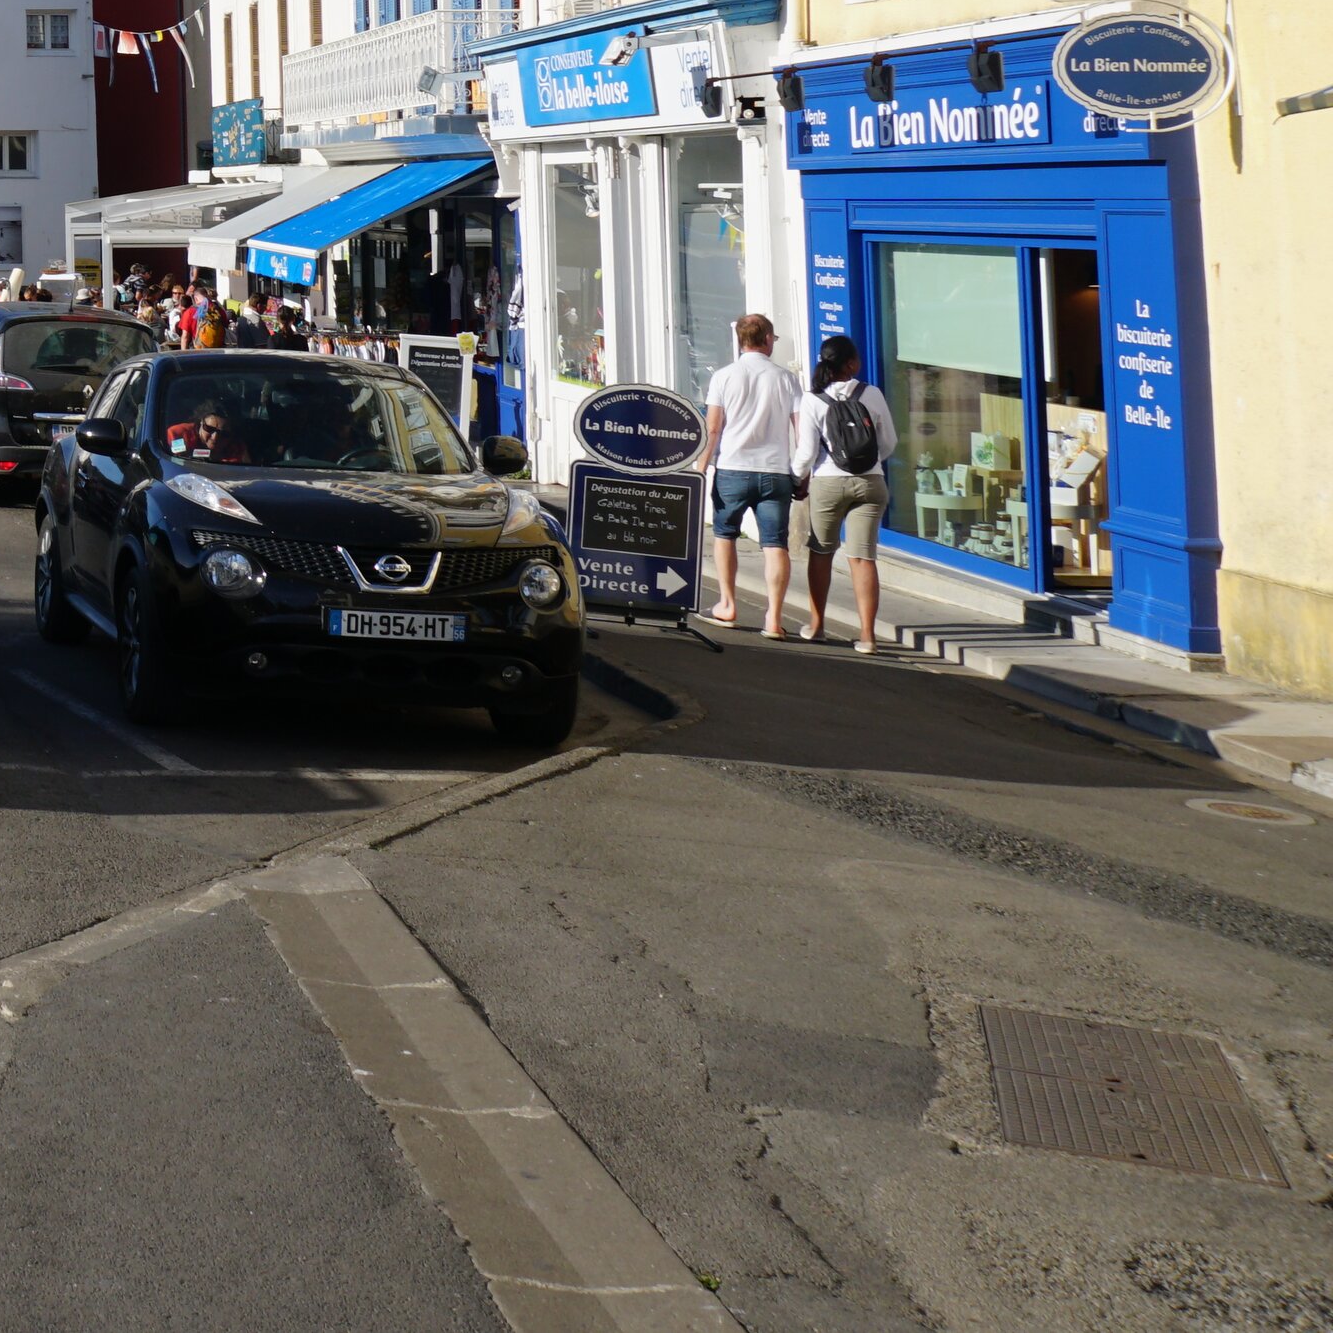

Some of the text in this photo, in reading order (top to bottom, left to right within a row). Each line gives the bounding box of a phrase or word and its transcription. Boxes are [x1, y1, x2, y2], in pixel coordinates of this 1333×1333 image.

[1084, 25, 1191, 47] Biscuiterie Confiserie
[550, 49, 594, 72] CONSERVERIE
[1071, 58, 1207, 73] La Bien Nommée
[552, 78, 565, 110] la
[804, 109, 827, 126] Vente
[850, 87, 1040, 148] La Bien Nommée
[803, 130, 830, 147] directe
[1135, 299, 1150, 318] La
[1116, 323, 1172, 347] biscuiterie
[1118, 351, 1173, 376] confiserie
[1139, 379, 1154, 399] de
[593, 393, 691, 421] Biscuiterie Confiserie
[1125, 404, 1172, 430] Belle-Île
[585, 418, 697, 441] La Bien Nommée
[595, 443, 623, 462] Maison
[625, 457, 652, 466] fondée
[666, 451, 684, 463] 1999
[591, 483, 685, 501] Dégustation du Jour
[597, 498, 637, 511] Galettes
[593, 513, 604, 522] de
[607, 532, 617, 540] au
[640, 536, 658, 545] noir
[578, 557, 634, 575] Vente
[578, 574, 649, 594] Directe
[346, 613, 449, 639] DH-954-HT
[454, 629, 465, 640] 56
